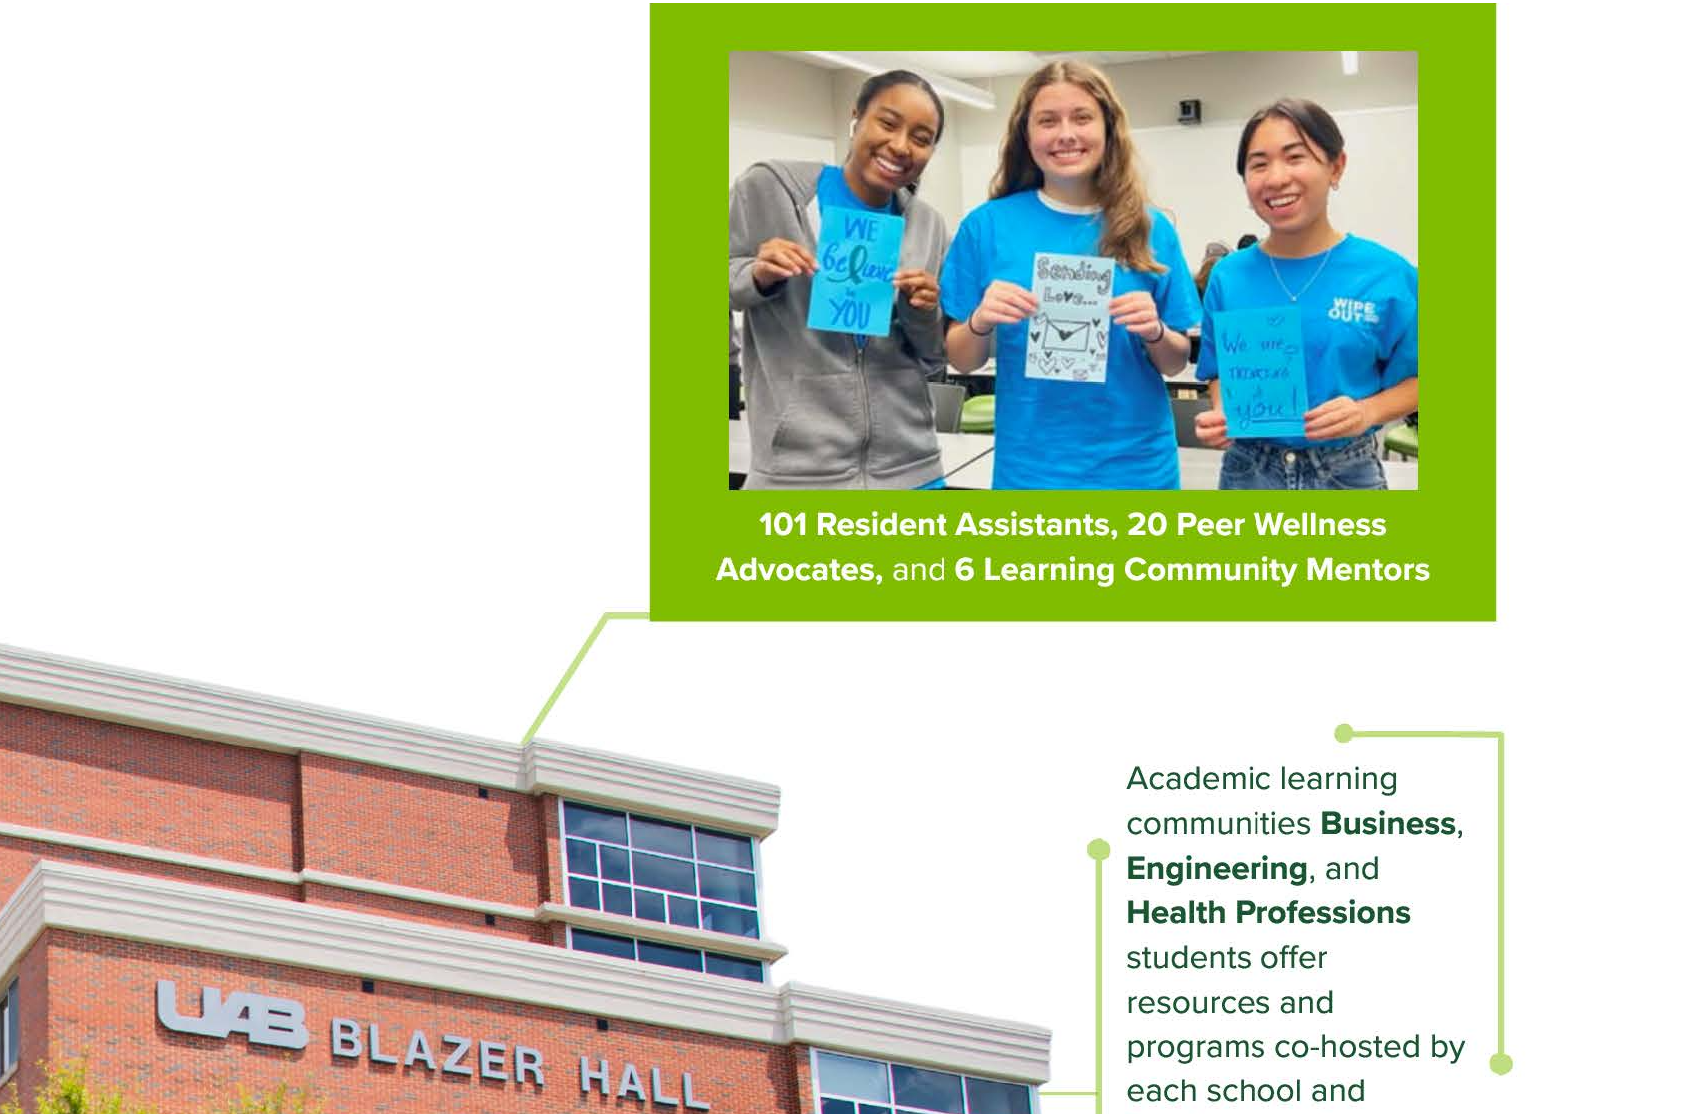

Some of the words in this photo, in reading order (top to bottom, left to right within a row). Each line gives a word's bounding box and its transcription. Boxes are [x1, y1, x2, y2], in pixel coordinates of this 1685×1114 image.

[844, 215, 878, 241] WE
[1037, 256, 1112, 295] Sending
[829, 298, 871, 330] YOU
[1328, 308, 1363, 323] OUT
[1333, 297, 1376, 315] WIPE
[156, 979, 309, 1050] UAB
[330, 1016, 546, 1087] BLAZER
[579, 1055, 712, 1112] HALL
